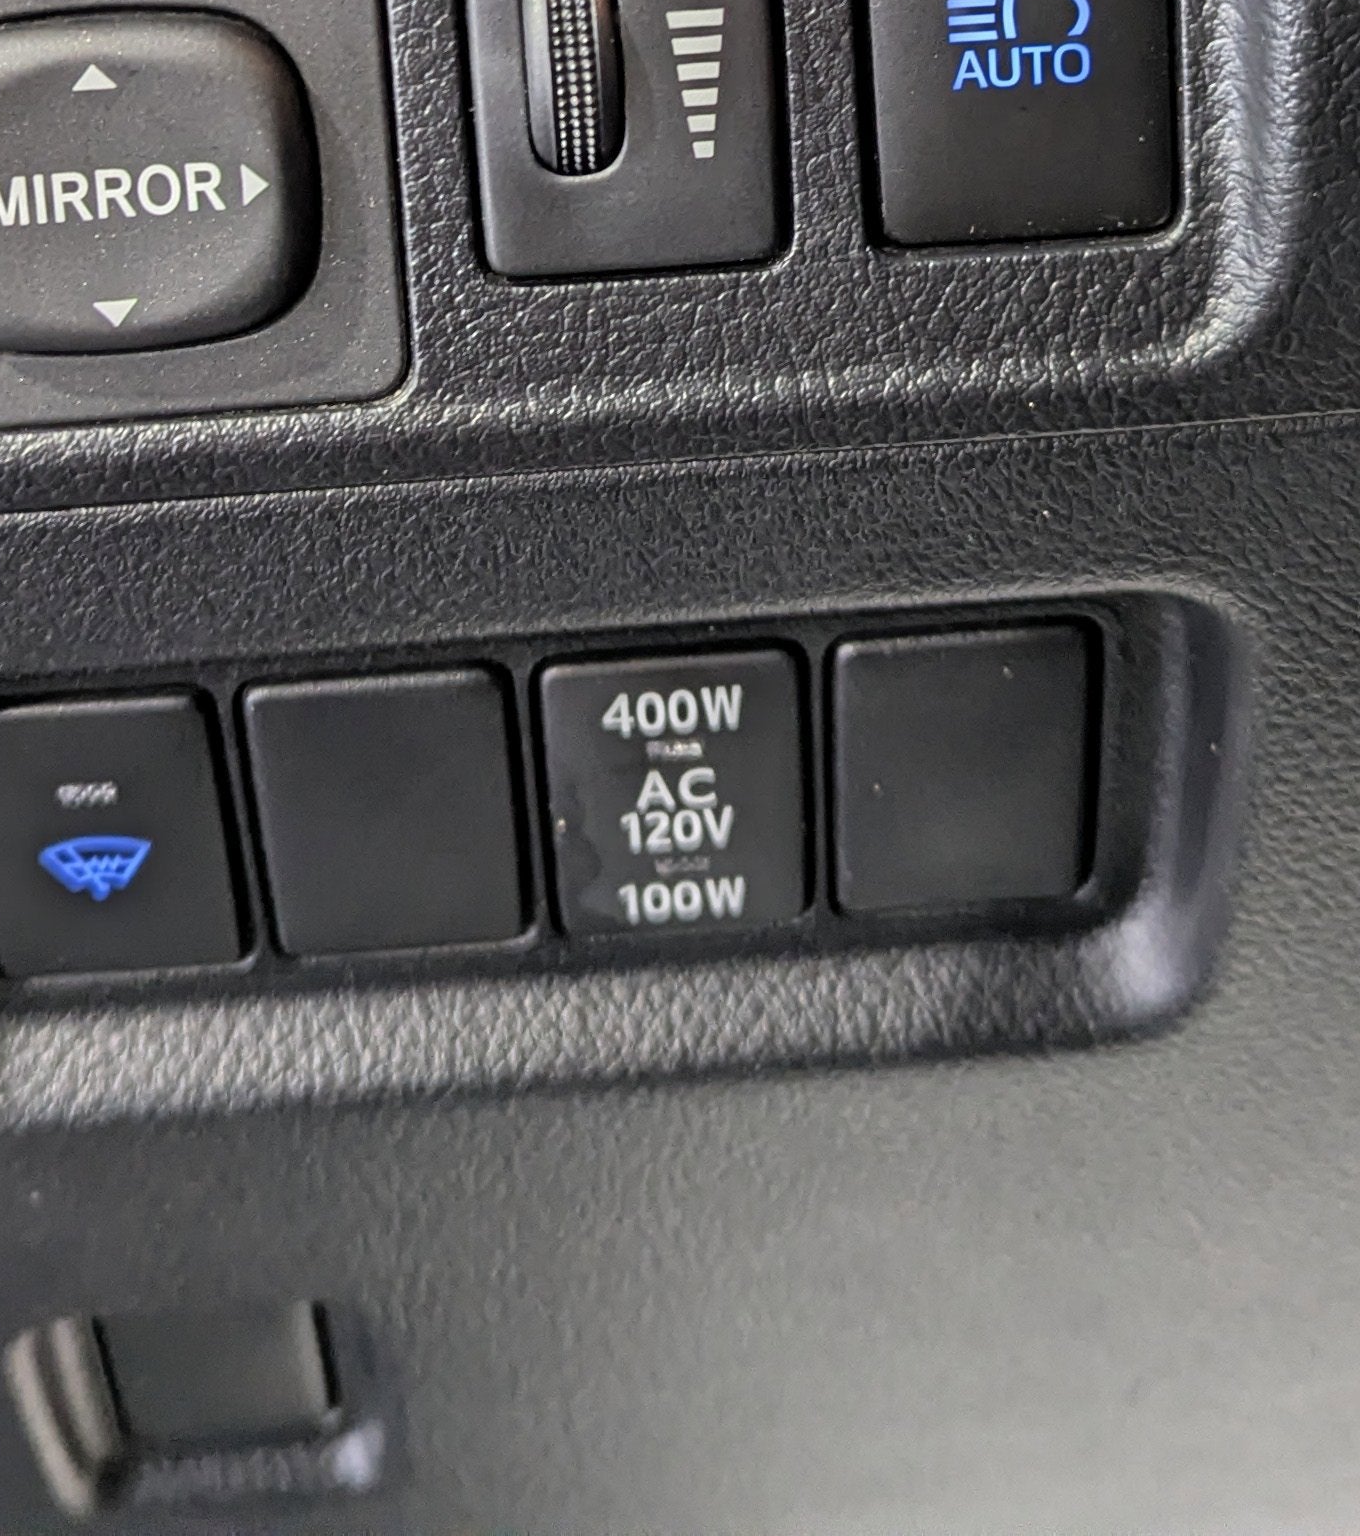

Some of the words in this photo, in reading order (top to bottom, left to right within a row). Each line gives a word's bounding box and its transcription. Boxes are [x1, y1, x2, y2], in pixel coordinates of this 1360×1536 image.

[952, 42, 1091, 91] AUTO
[601, 683, 743, 739] 400W
[636, 766, 718, 814] AC
[619, 804, 735, 856] 120V
[617, 875, 747, 927] 100W
